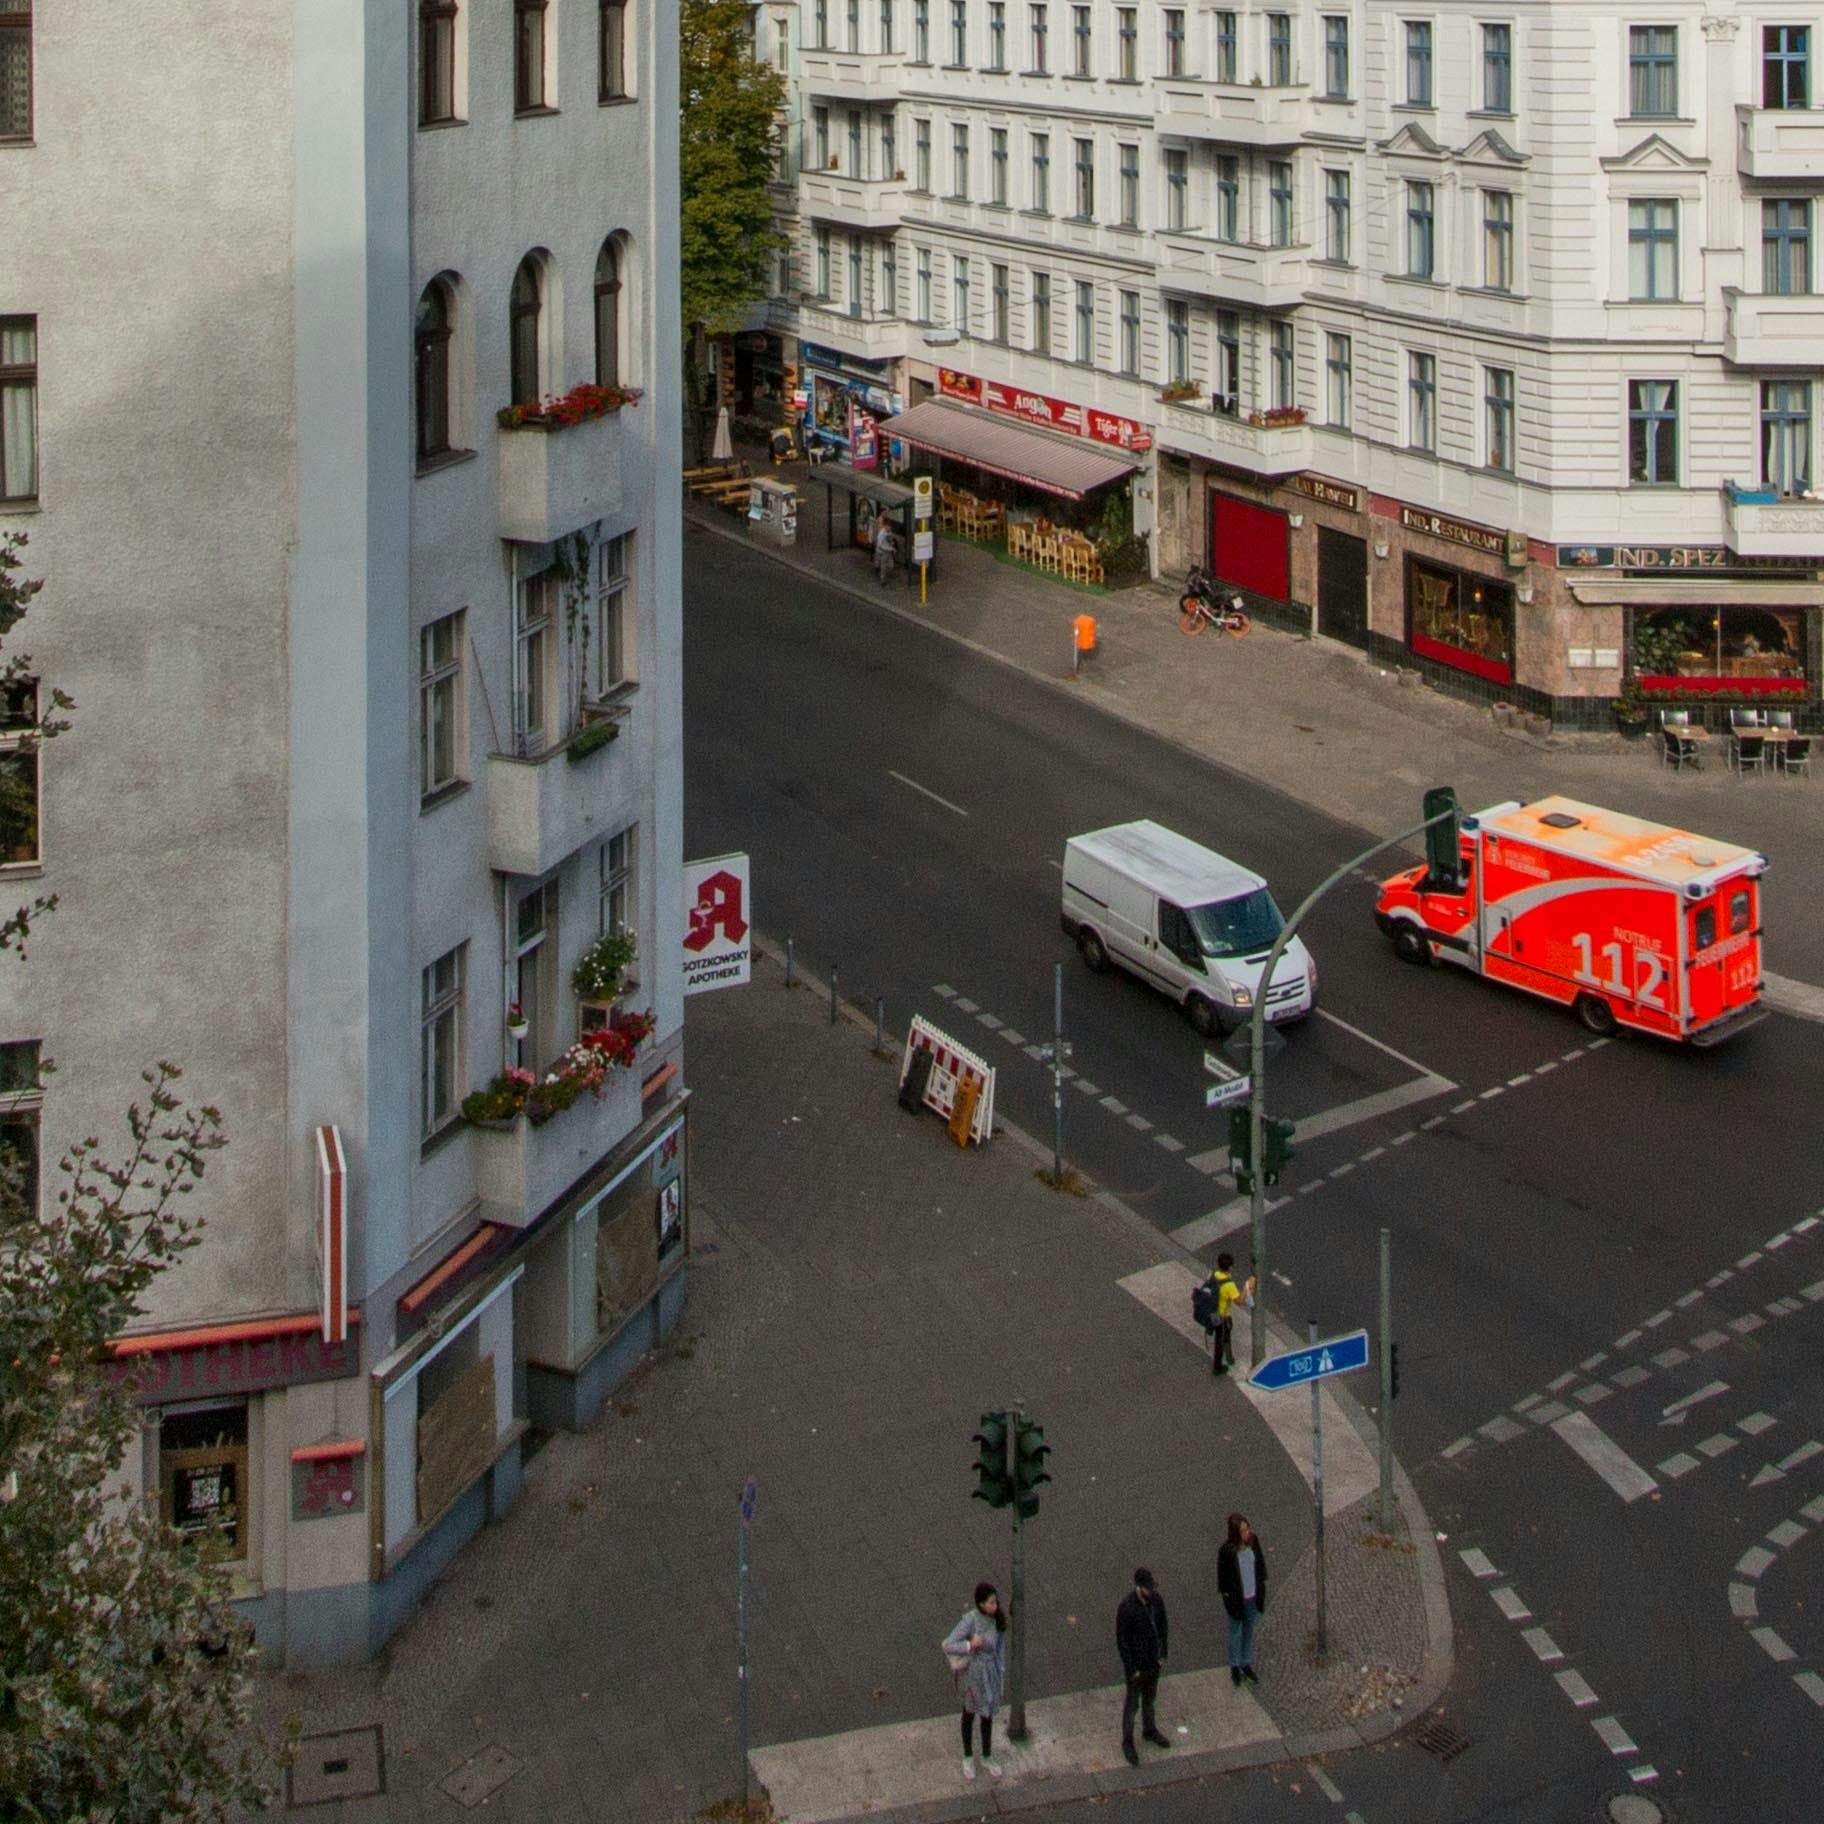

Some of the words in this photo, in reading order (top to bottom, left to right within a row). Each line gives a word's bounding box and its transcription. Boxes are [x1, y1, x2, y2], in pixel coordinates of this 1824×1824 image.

[1095, 417, 1118, 439] Tiger
[1431, 517, 1505, 553] RESTAURANT
[1613, 546, 1666, 568] IND.
[688, 965, 741, 986] APOTHEKE
[1572, 931, 1665, 1009] 112
[1731, 960, 1754, 991] 112
